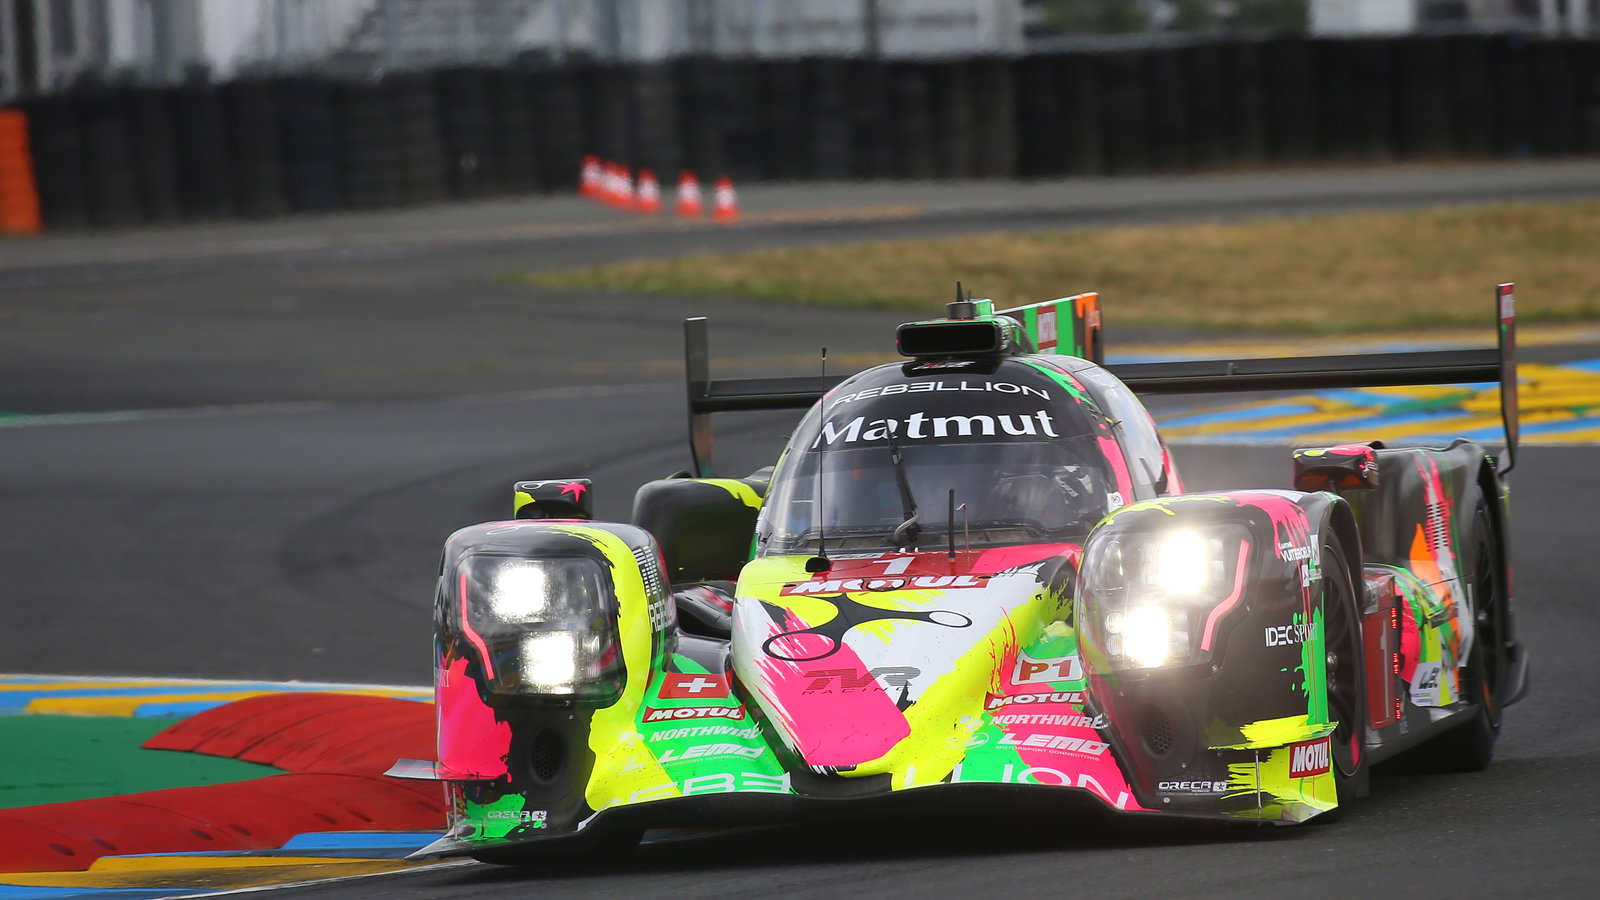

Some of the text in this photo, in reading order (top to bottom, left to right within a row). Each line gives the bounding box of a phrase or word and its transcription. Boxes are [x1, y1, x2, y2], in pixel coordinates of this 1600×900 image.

[828, 380, 1051, 409] REBELLION
[811, 409, 1060, 450] Matmut
[872, 556, 916, 575] 1
[1264, 625, 1294, 647] IDEC
[1294, 622, 1319, 643] SPORT
[1018, 659, 1072, 682] P1
[987, 692, 1085, 709] MOTUL
[646, 707, 744, 722] MOTUL
[989, 713, 1111, 730] NORTHWIRE
[649, 721, 764, 743] NORTHWIRE
[656, 742, 767, 764] LEMO
[995, 745, 1100, 762] MOTORSPORT CONNECTORS
[996, 732, 1110, 756] LEMO
[1291, 744, 1329, 774] MOTUL
[1158, 781, 1212, 790] ORECA
[487, 810, 531, 820] ORECA
